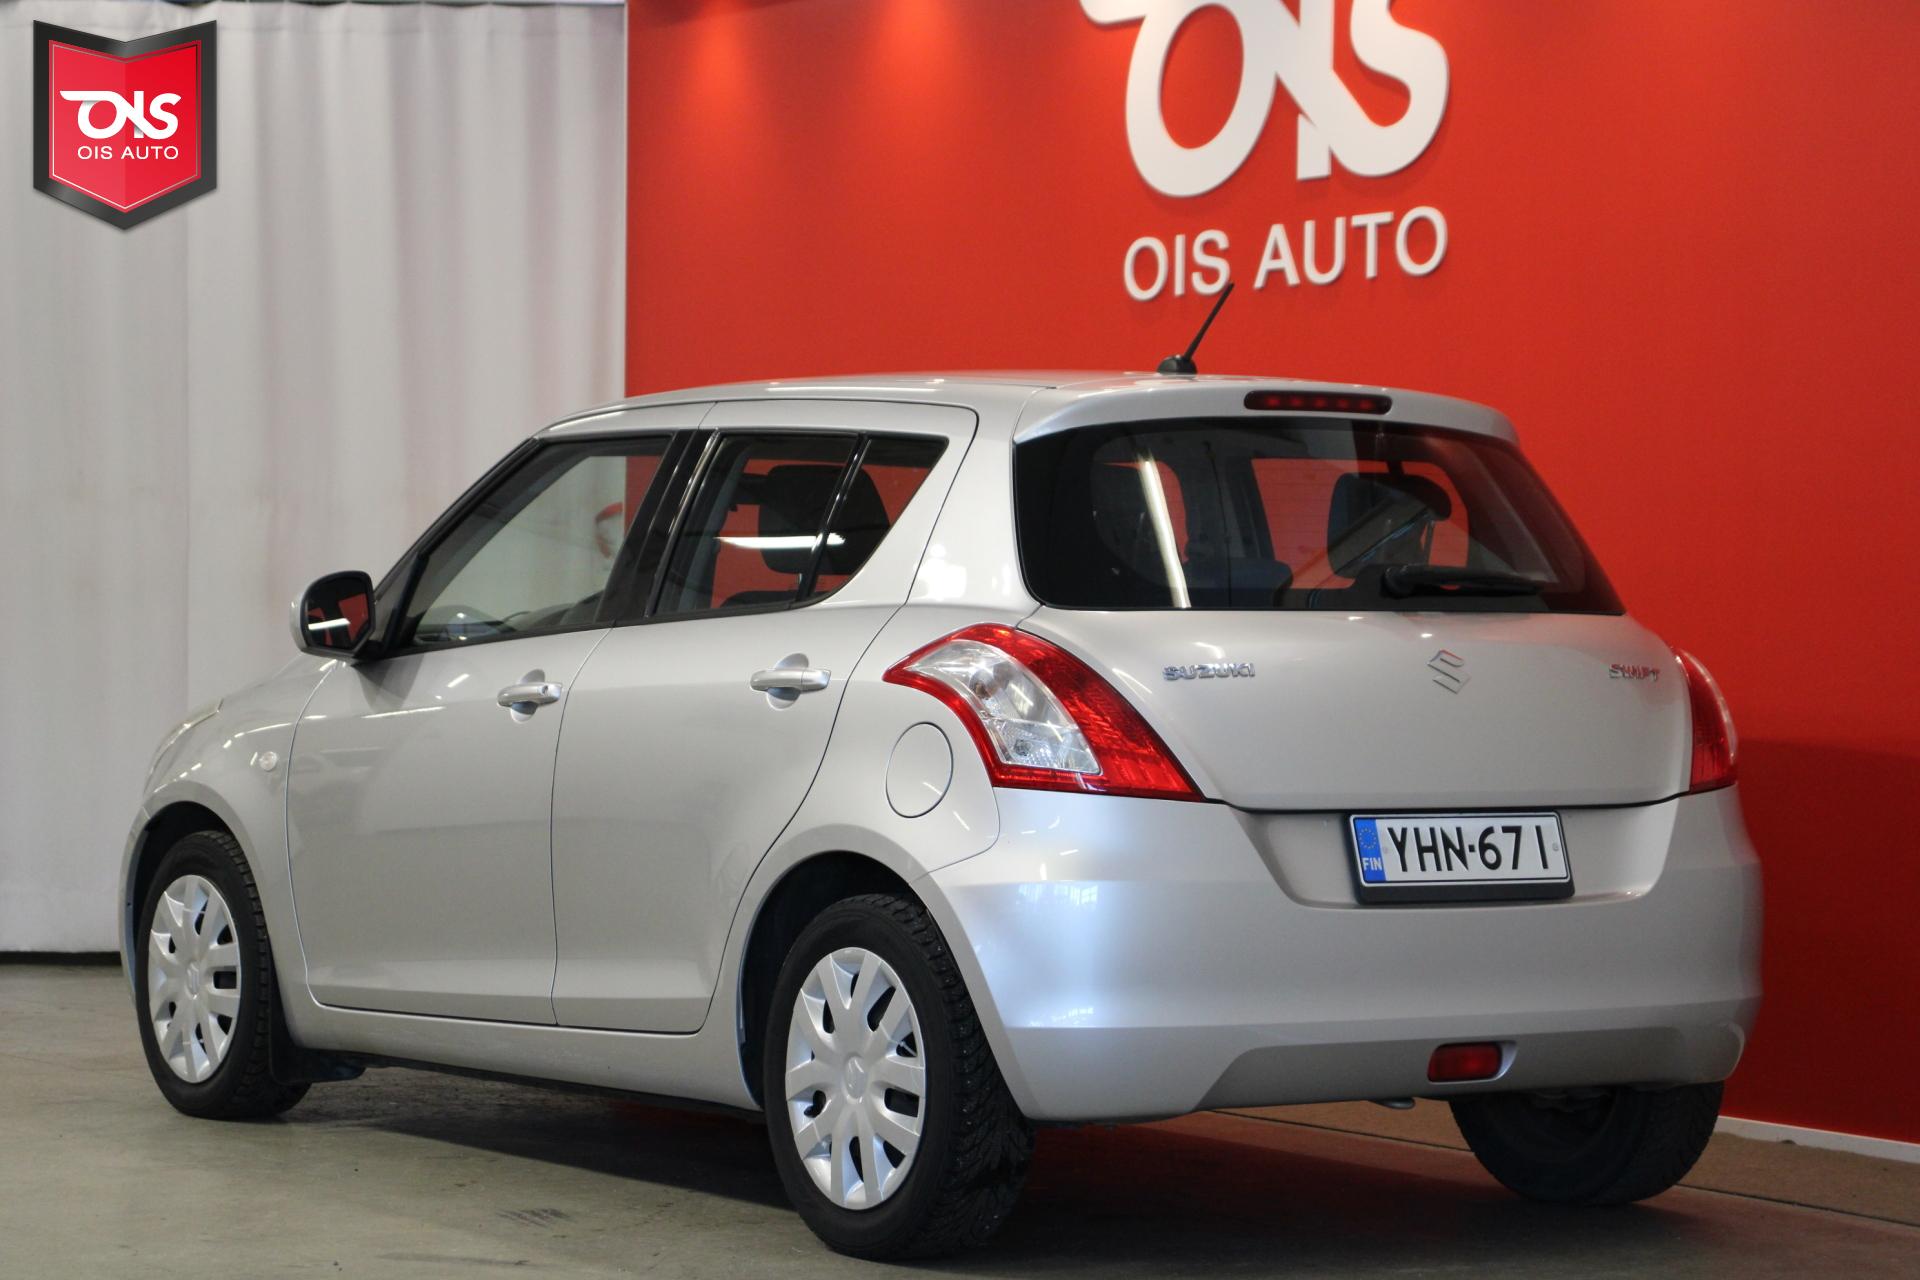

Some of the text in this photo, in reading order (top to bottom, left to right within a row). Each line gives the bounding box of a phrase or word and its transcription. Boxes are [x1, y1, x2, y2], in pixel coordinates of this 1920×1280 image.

[1123, 205, 1449, 301] OIS AUTO
[1162, 662, 1256, 681] SUZUKI
[1362, 857, 1384, 872] FIN
[1387, 825, 1549, 873] YHN-671
